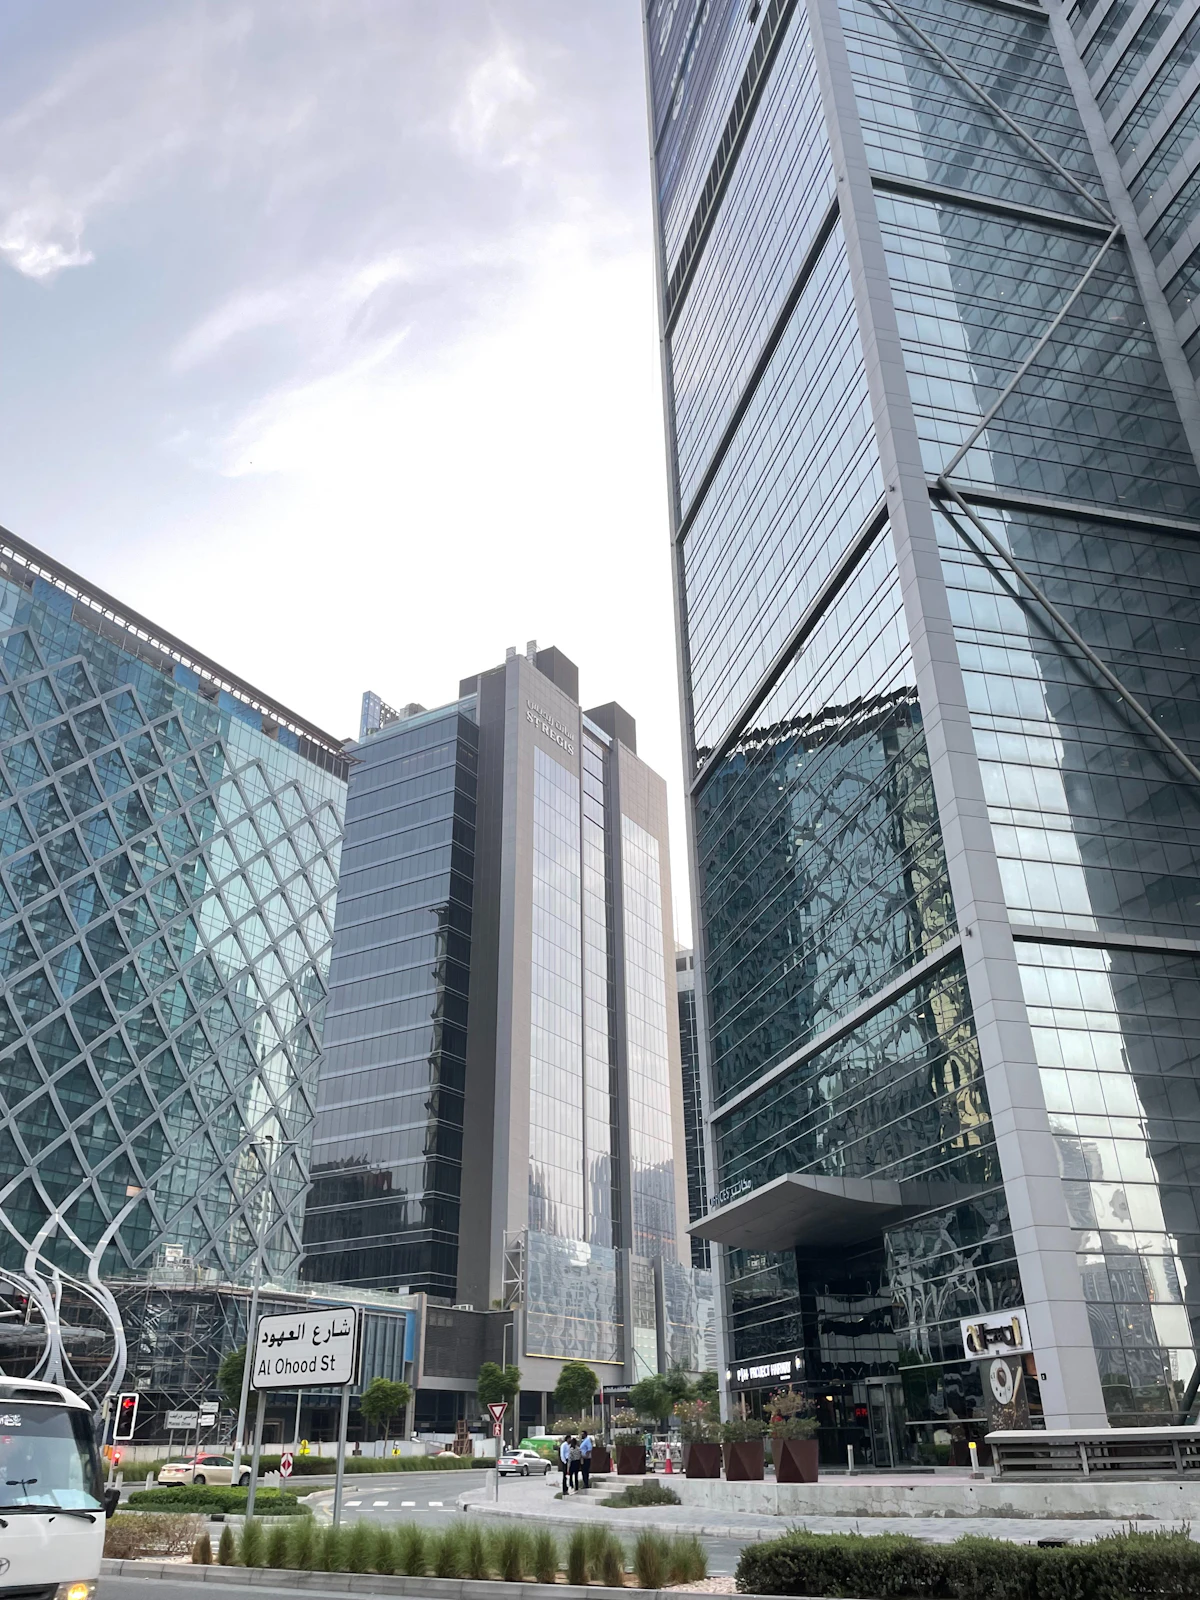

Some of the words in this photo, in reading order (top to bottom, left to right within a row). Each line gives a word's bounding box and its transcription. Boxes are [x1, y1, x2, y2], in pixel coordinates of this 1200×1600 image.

[541, 722, 574, 756] REGIS
[261, 1322, 305, 1348] العهود
[312, 1319, 351, 1346] شارع
[257, 1359, 271, 1376] Al
[275, 1356, 317, 1375] Ohood
[320, 1354, 336, 1371] St
